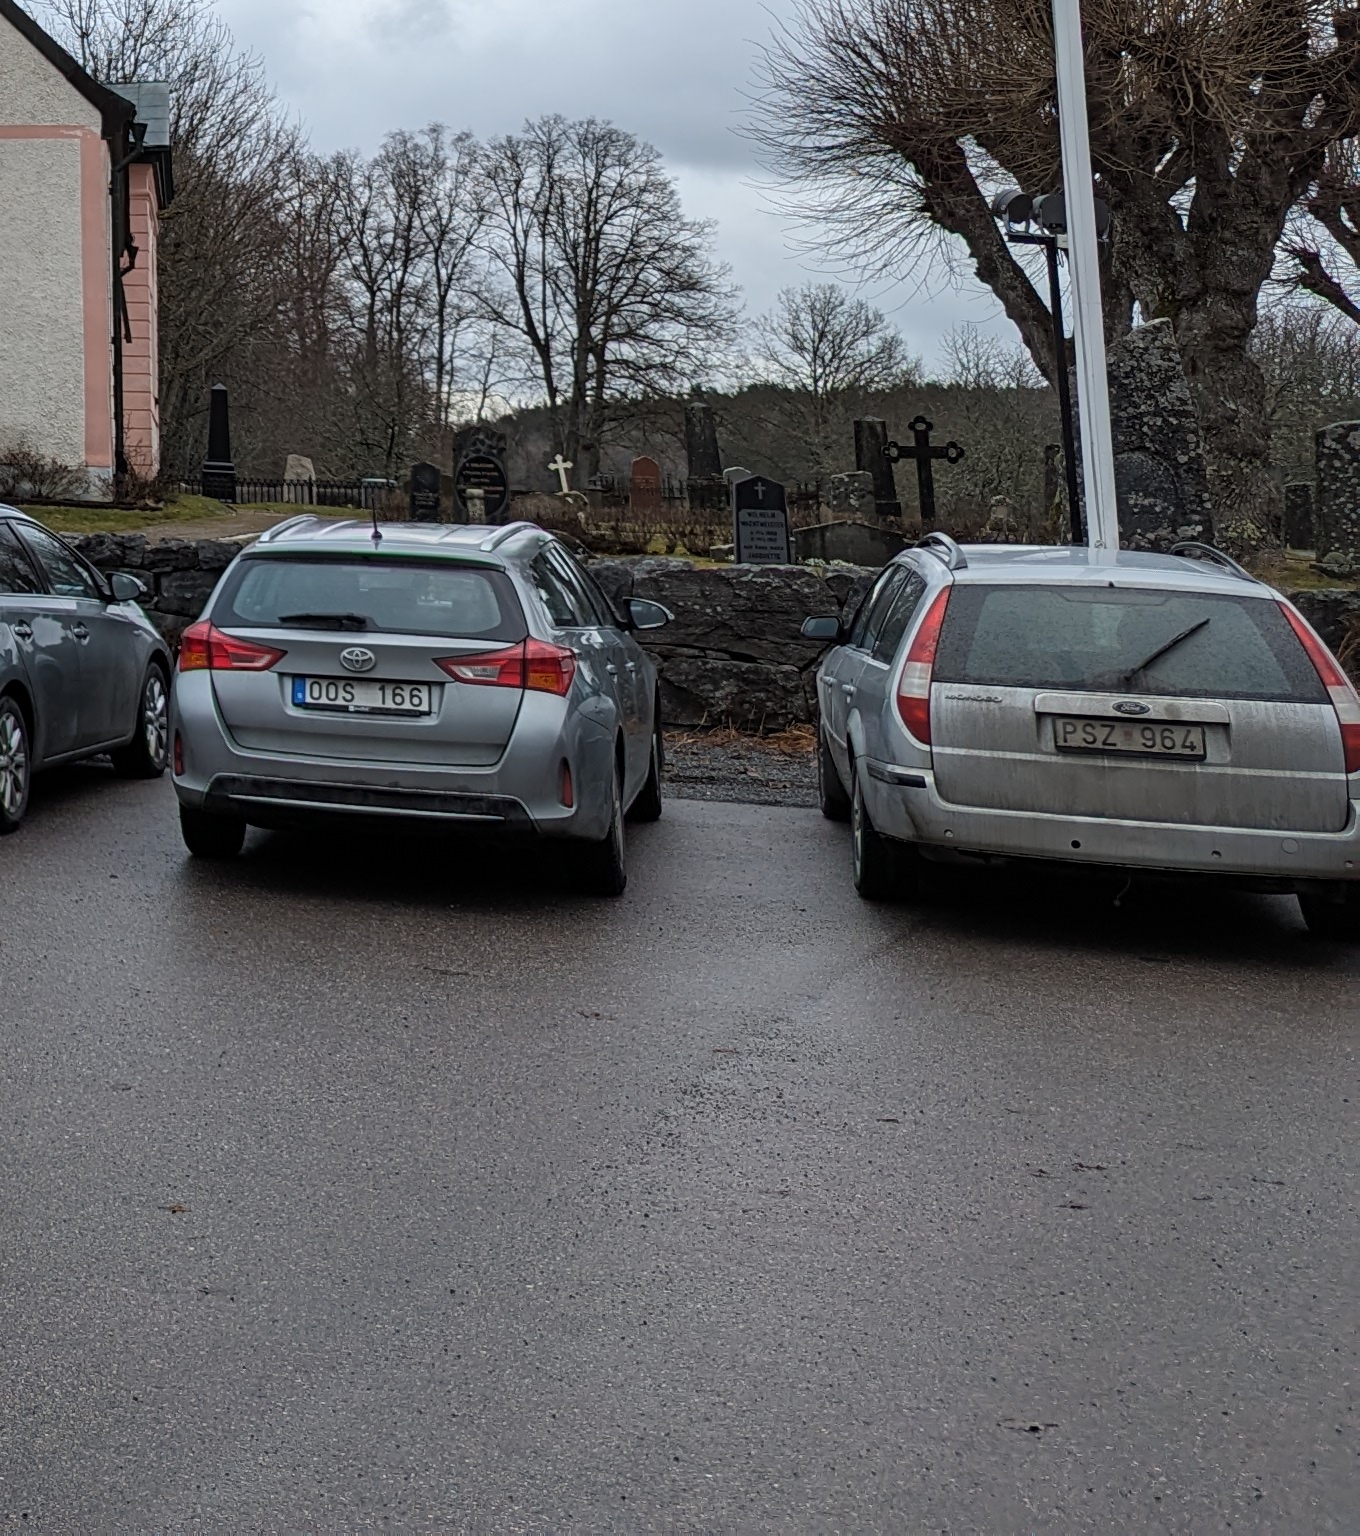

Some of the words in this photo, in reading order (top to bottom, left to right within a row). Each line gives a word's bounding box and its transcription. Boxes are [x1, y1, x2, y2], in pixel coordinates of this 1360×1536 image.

[309, 680, 355, 703] OOS
[378, 683, 423, 708] 166
[944, 694, 1003, 703] MONDEO
[1062, 721, 1117, 747] PSZ
[1140, 726, 1197, 752] 964
